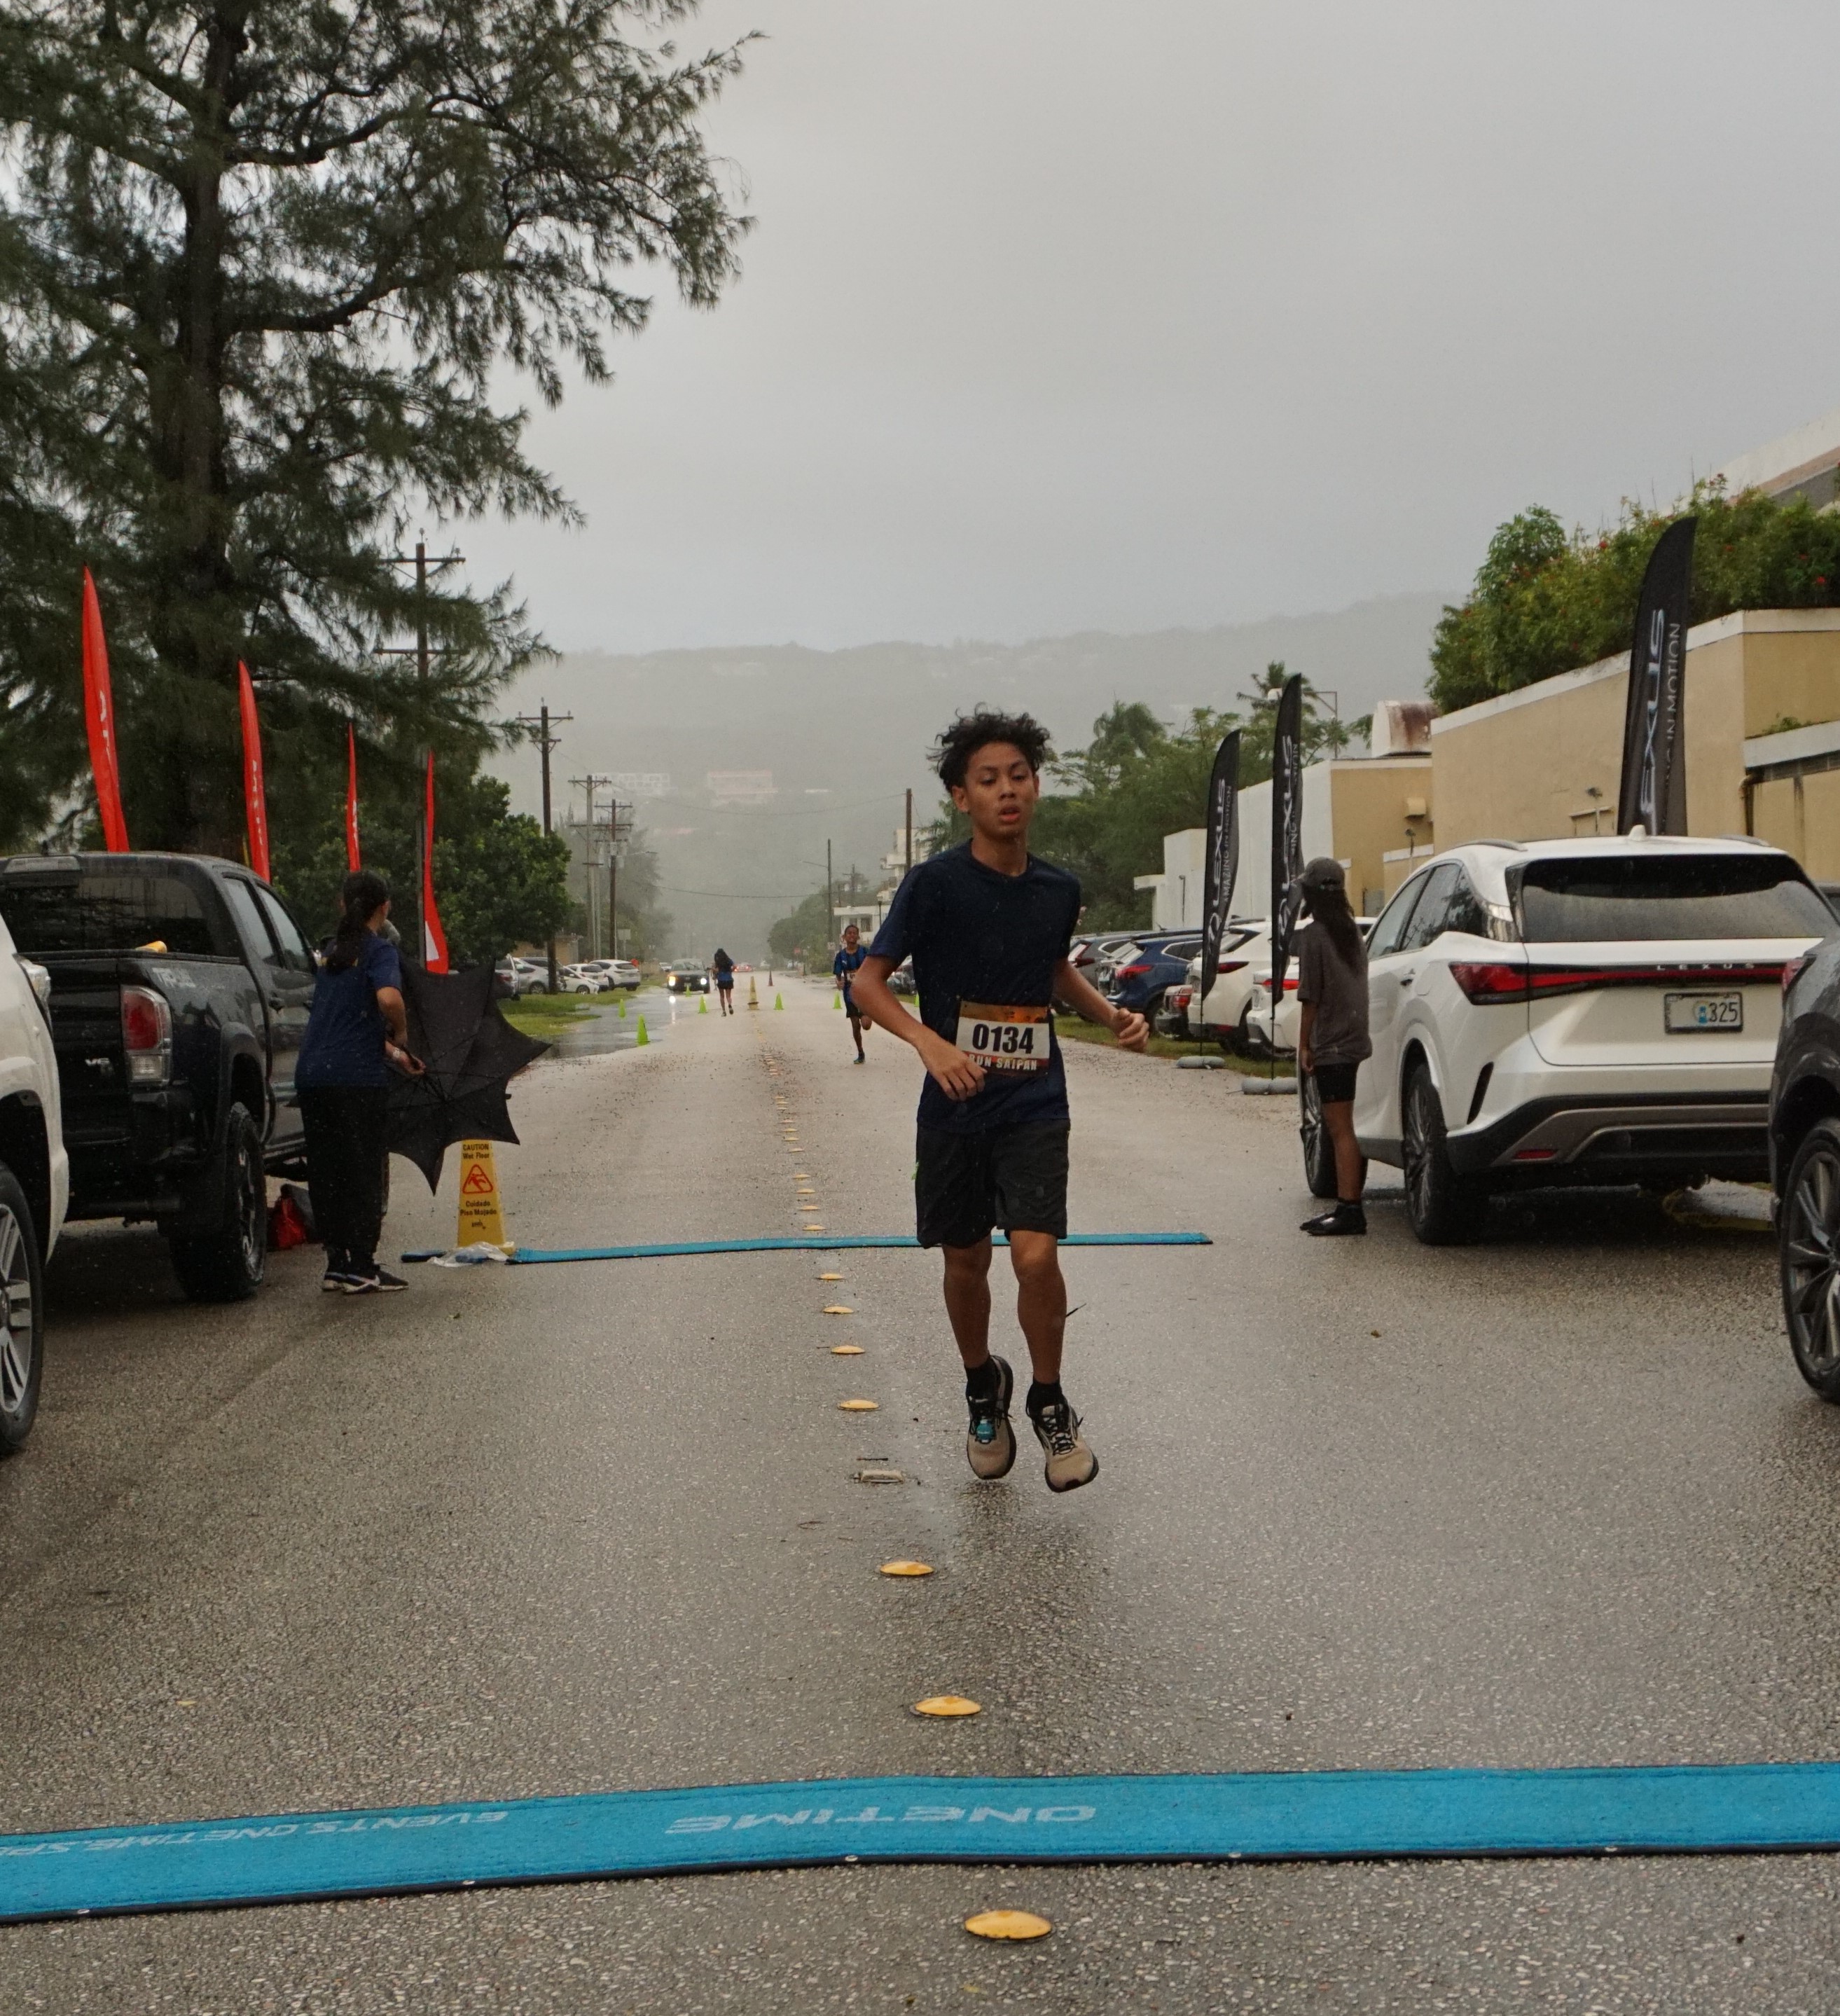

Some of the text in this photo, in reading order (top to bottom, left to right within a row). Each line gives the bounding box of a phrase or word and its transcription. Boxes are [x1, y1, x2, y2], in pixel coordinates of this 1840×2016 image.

[1666, 623, 1680, 712] MOTION
[1281, 735, 1292, 892] LEXUS
[1213, 779, 1225, 906] LEXUS
[1708, 1002, 1738, 1022] 325
[972, 1023, 1034, 1054] 0134
[969, 1055, 1037, 1071] RUN SAIPAN
[665, 1805, 1097, 1834] ONETIME
